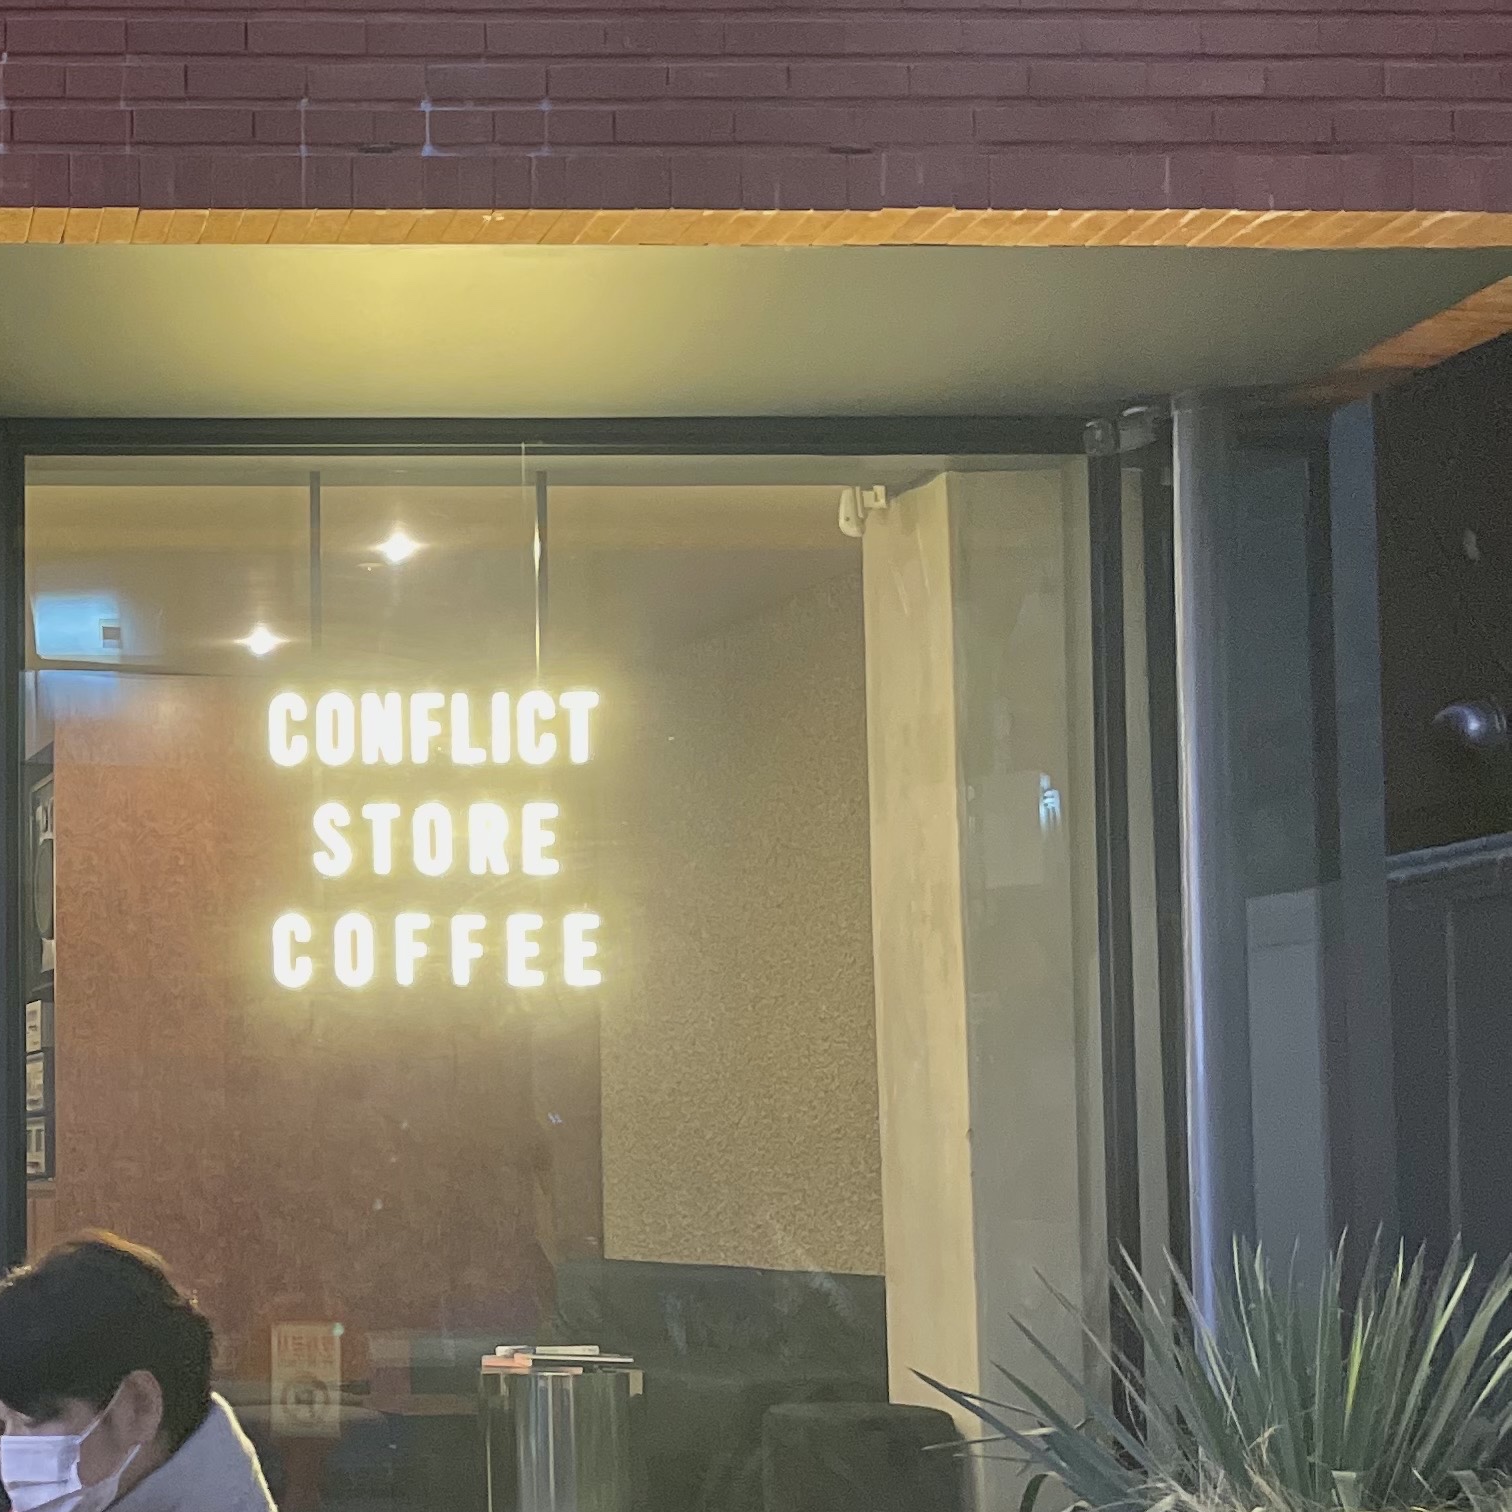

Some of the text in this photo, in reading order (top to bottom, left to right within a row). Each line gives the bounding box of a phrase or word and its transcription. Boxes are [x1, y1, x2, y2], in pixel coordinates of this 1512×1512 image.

[267, 690, 600, 767] CONFLICT
[312, 801, 561, 877] STORE
[271, 911, 603, 989] COFFEE
